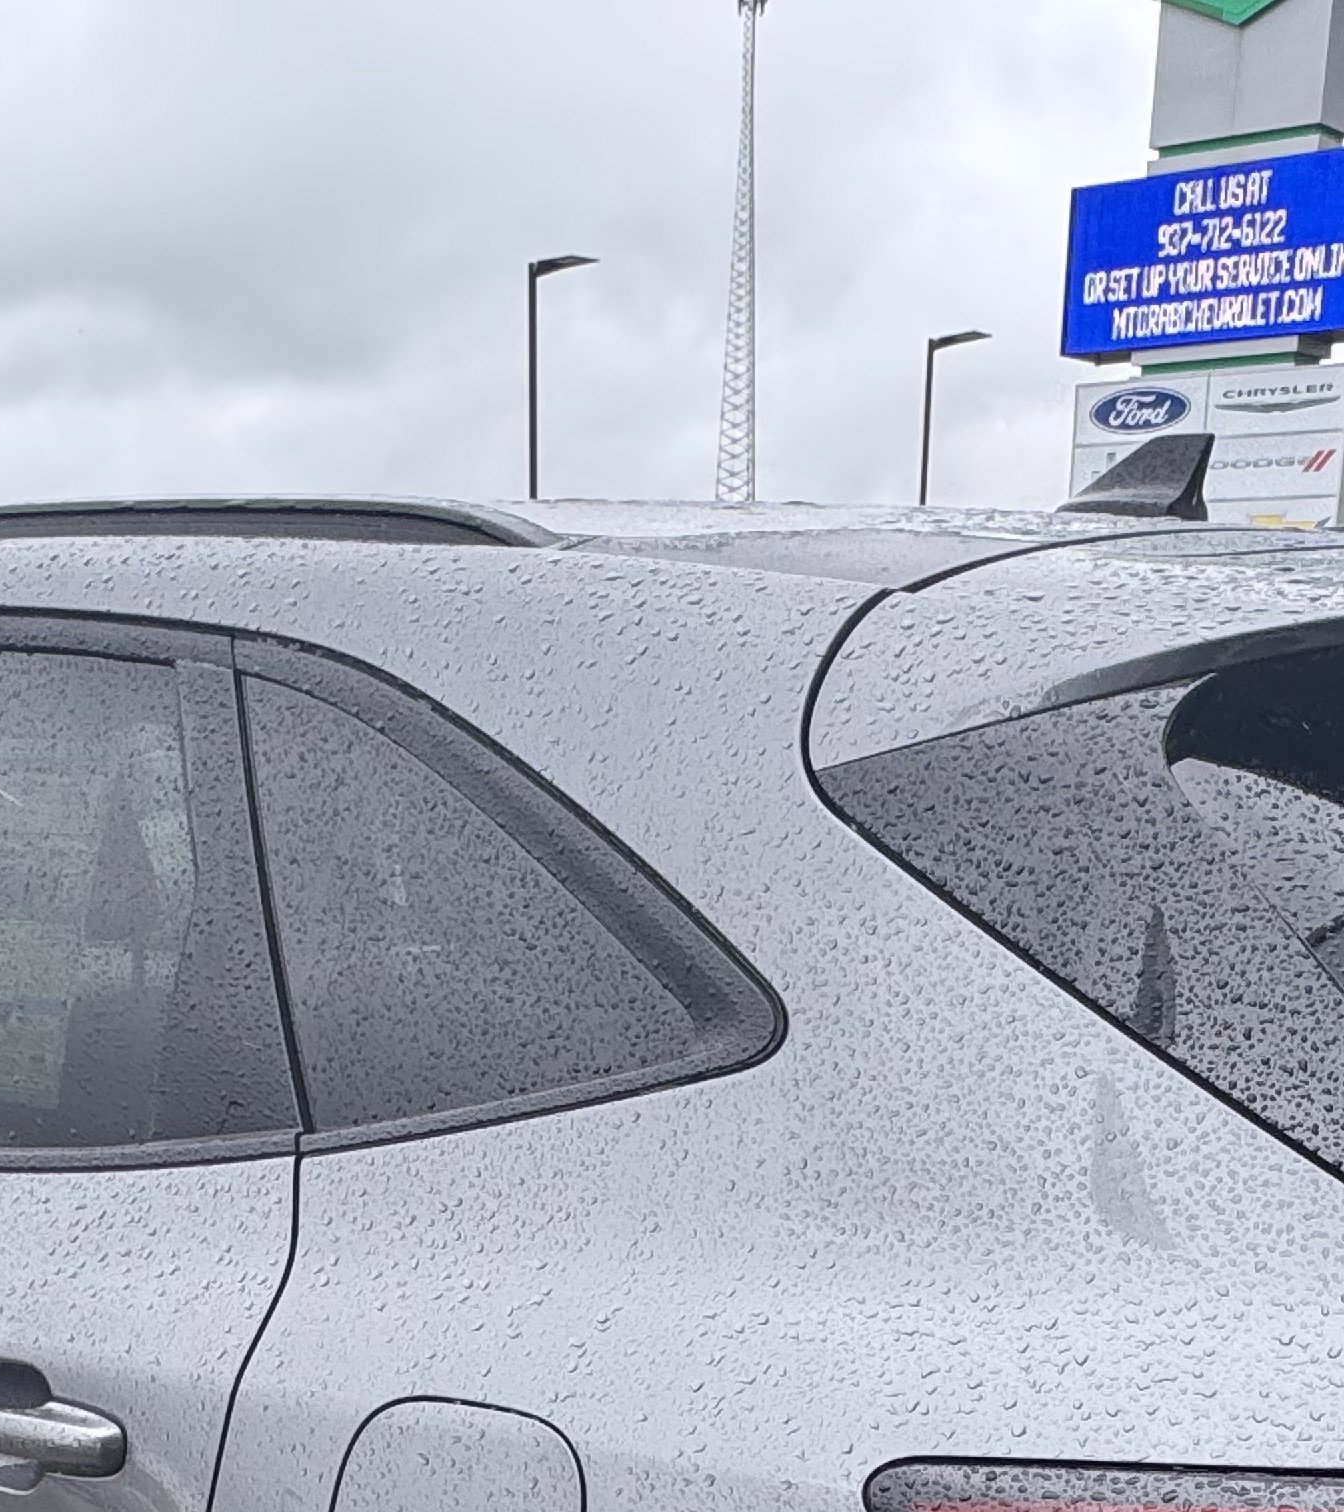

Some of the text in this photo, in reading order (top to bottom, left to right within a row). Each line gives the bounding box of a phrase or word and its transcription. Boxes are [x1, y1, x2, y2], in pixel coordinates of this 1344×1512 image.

[1173, 169, 1274, 215] CALL US AT
[1158, 208, 1288, 258] 937-712-6122
[1083, 270, 1106, 305] OR
[1106, 266, 1141, 303] SET
[1141, 264, 1166, 299] UP
[1168, 257, 1214, 296] YOUR
[1216, 248, 1294, 291] SERVICE
[1109, 394, 1172, 426] Ford
[1222, 382, 1334, 400] CHRYSLER
